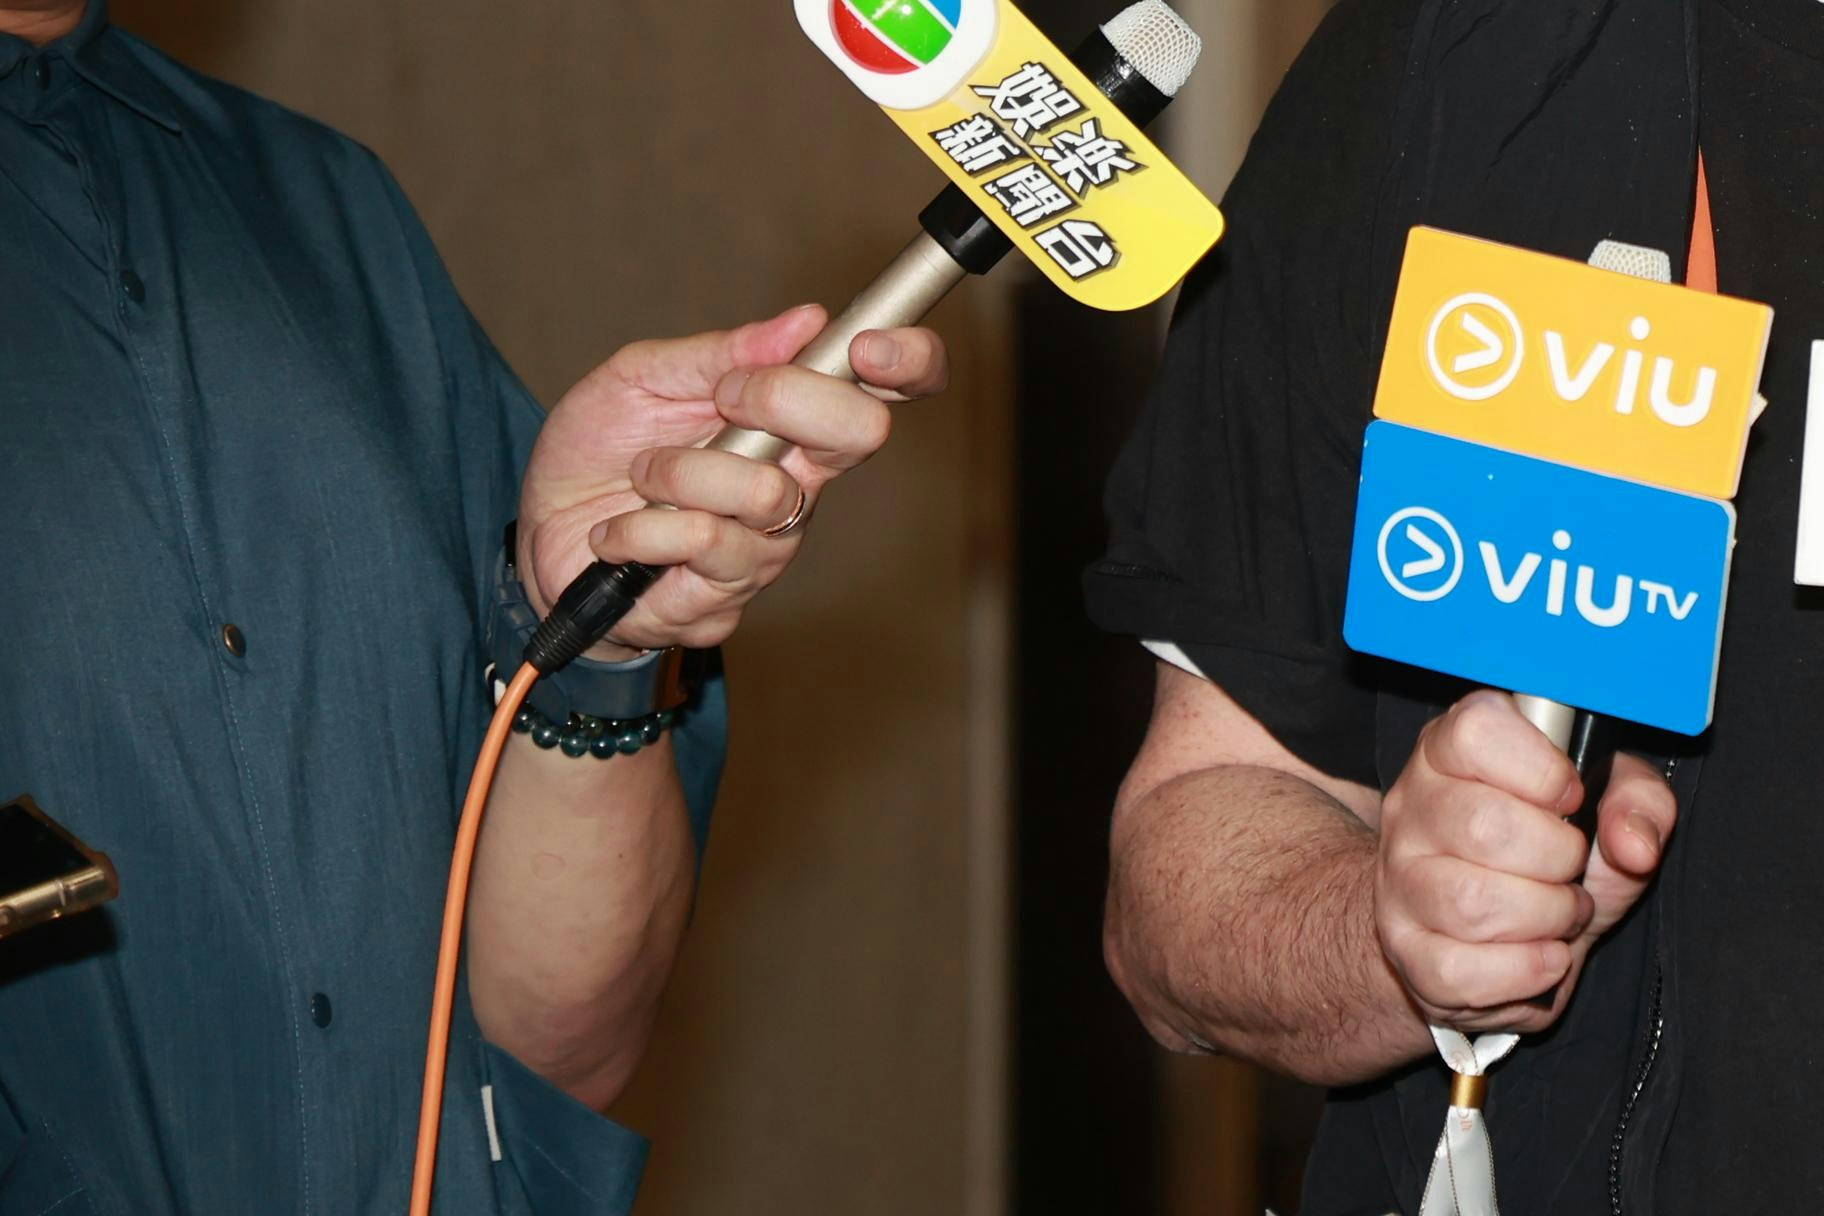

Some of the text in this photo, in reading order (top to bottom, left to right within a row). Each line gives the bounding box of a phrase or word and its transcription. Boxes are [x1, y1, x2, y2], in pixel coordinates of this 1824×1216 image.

[929, 113, 1120, 281] 新聞台
[1543, 315, 1717, 427] viu
